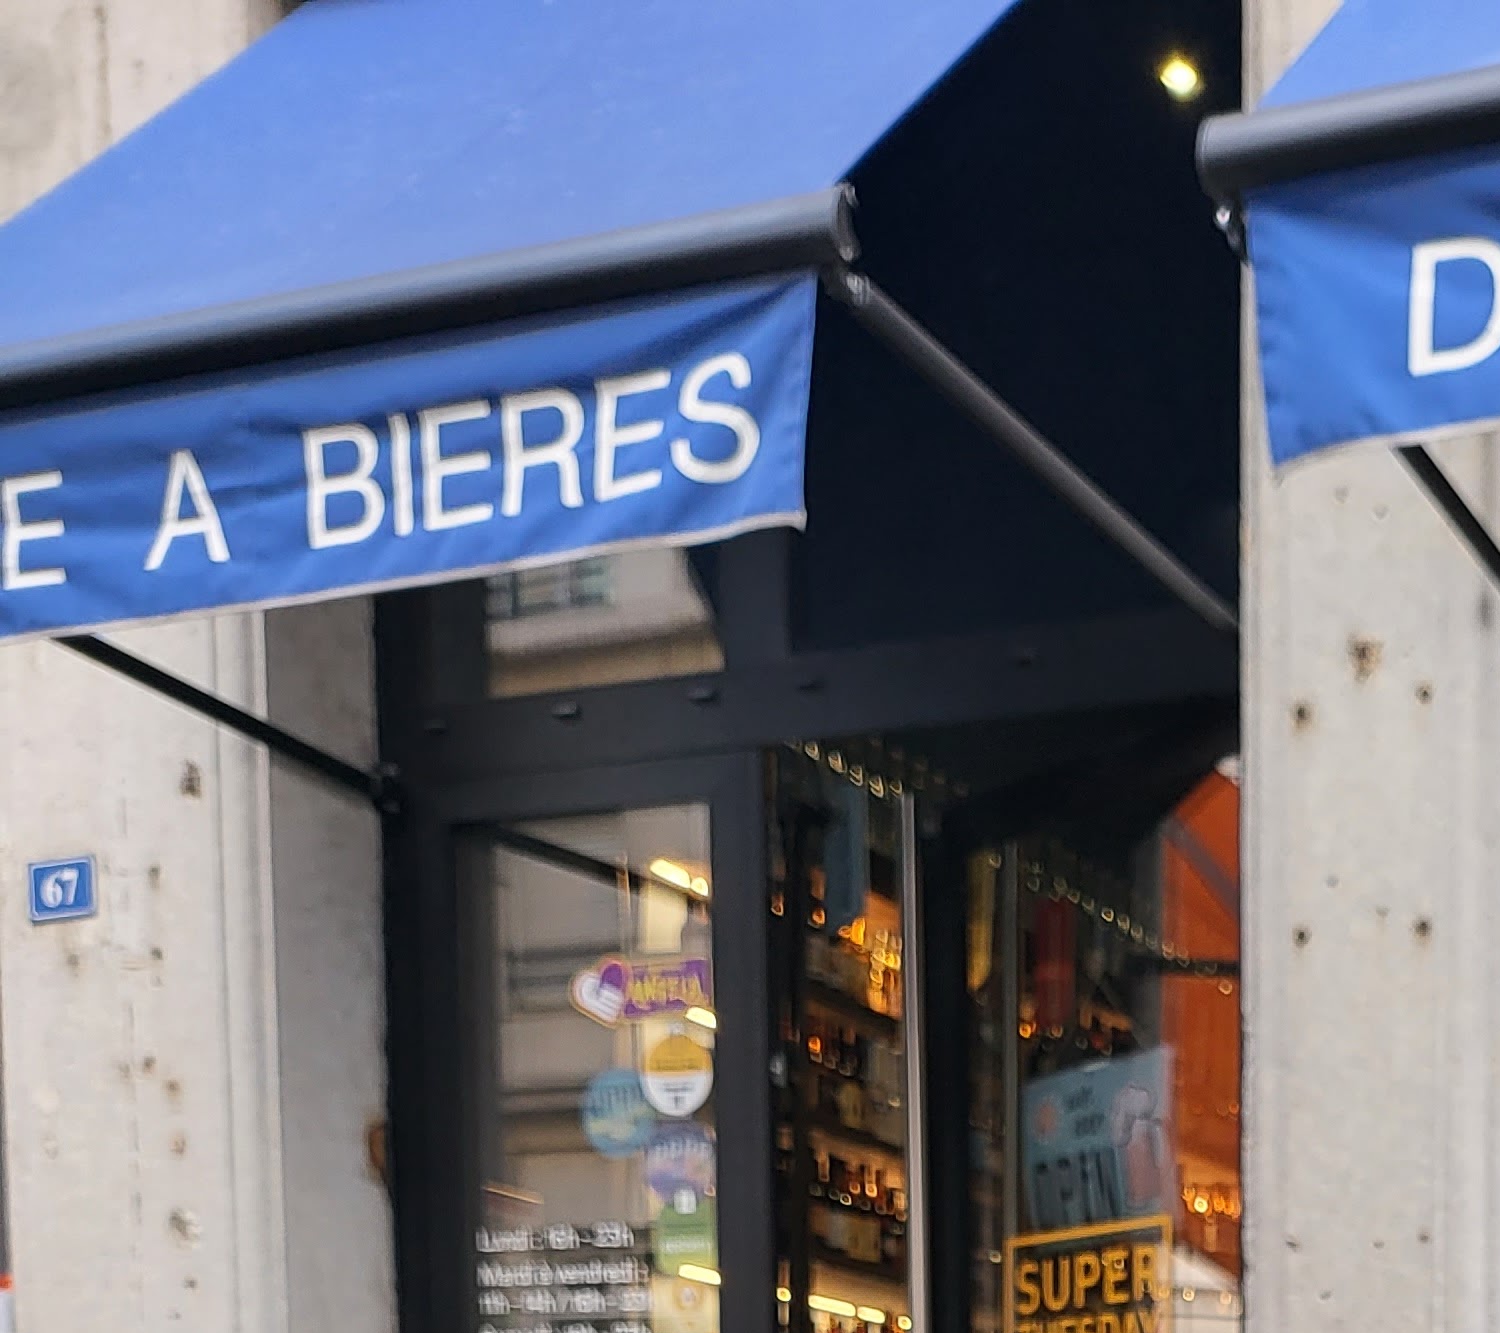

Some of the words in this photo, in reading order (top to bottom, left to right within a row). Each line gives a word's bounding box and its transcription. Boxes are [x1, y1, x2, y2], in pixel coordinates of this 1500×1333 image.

[144, 448, 231, 571] A
[303, 352, 762, 551] BIERES
[41, 866, 80, 909] 67
[1015, 1243, 1161, 1316] SUPER
